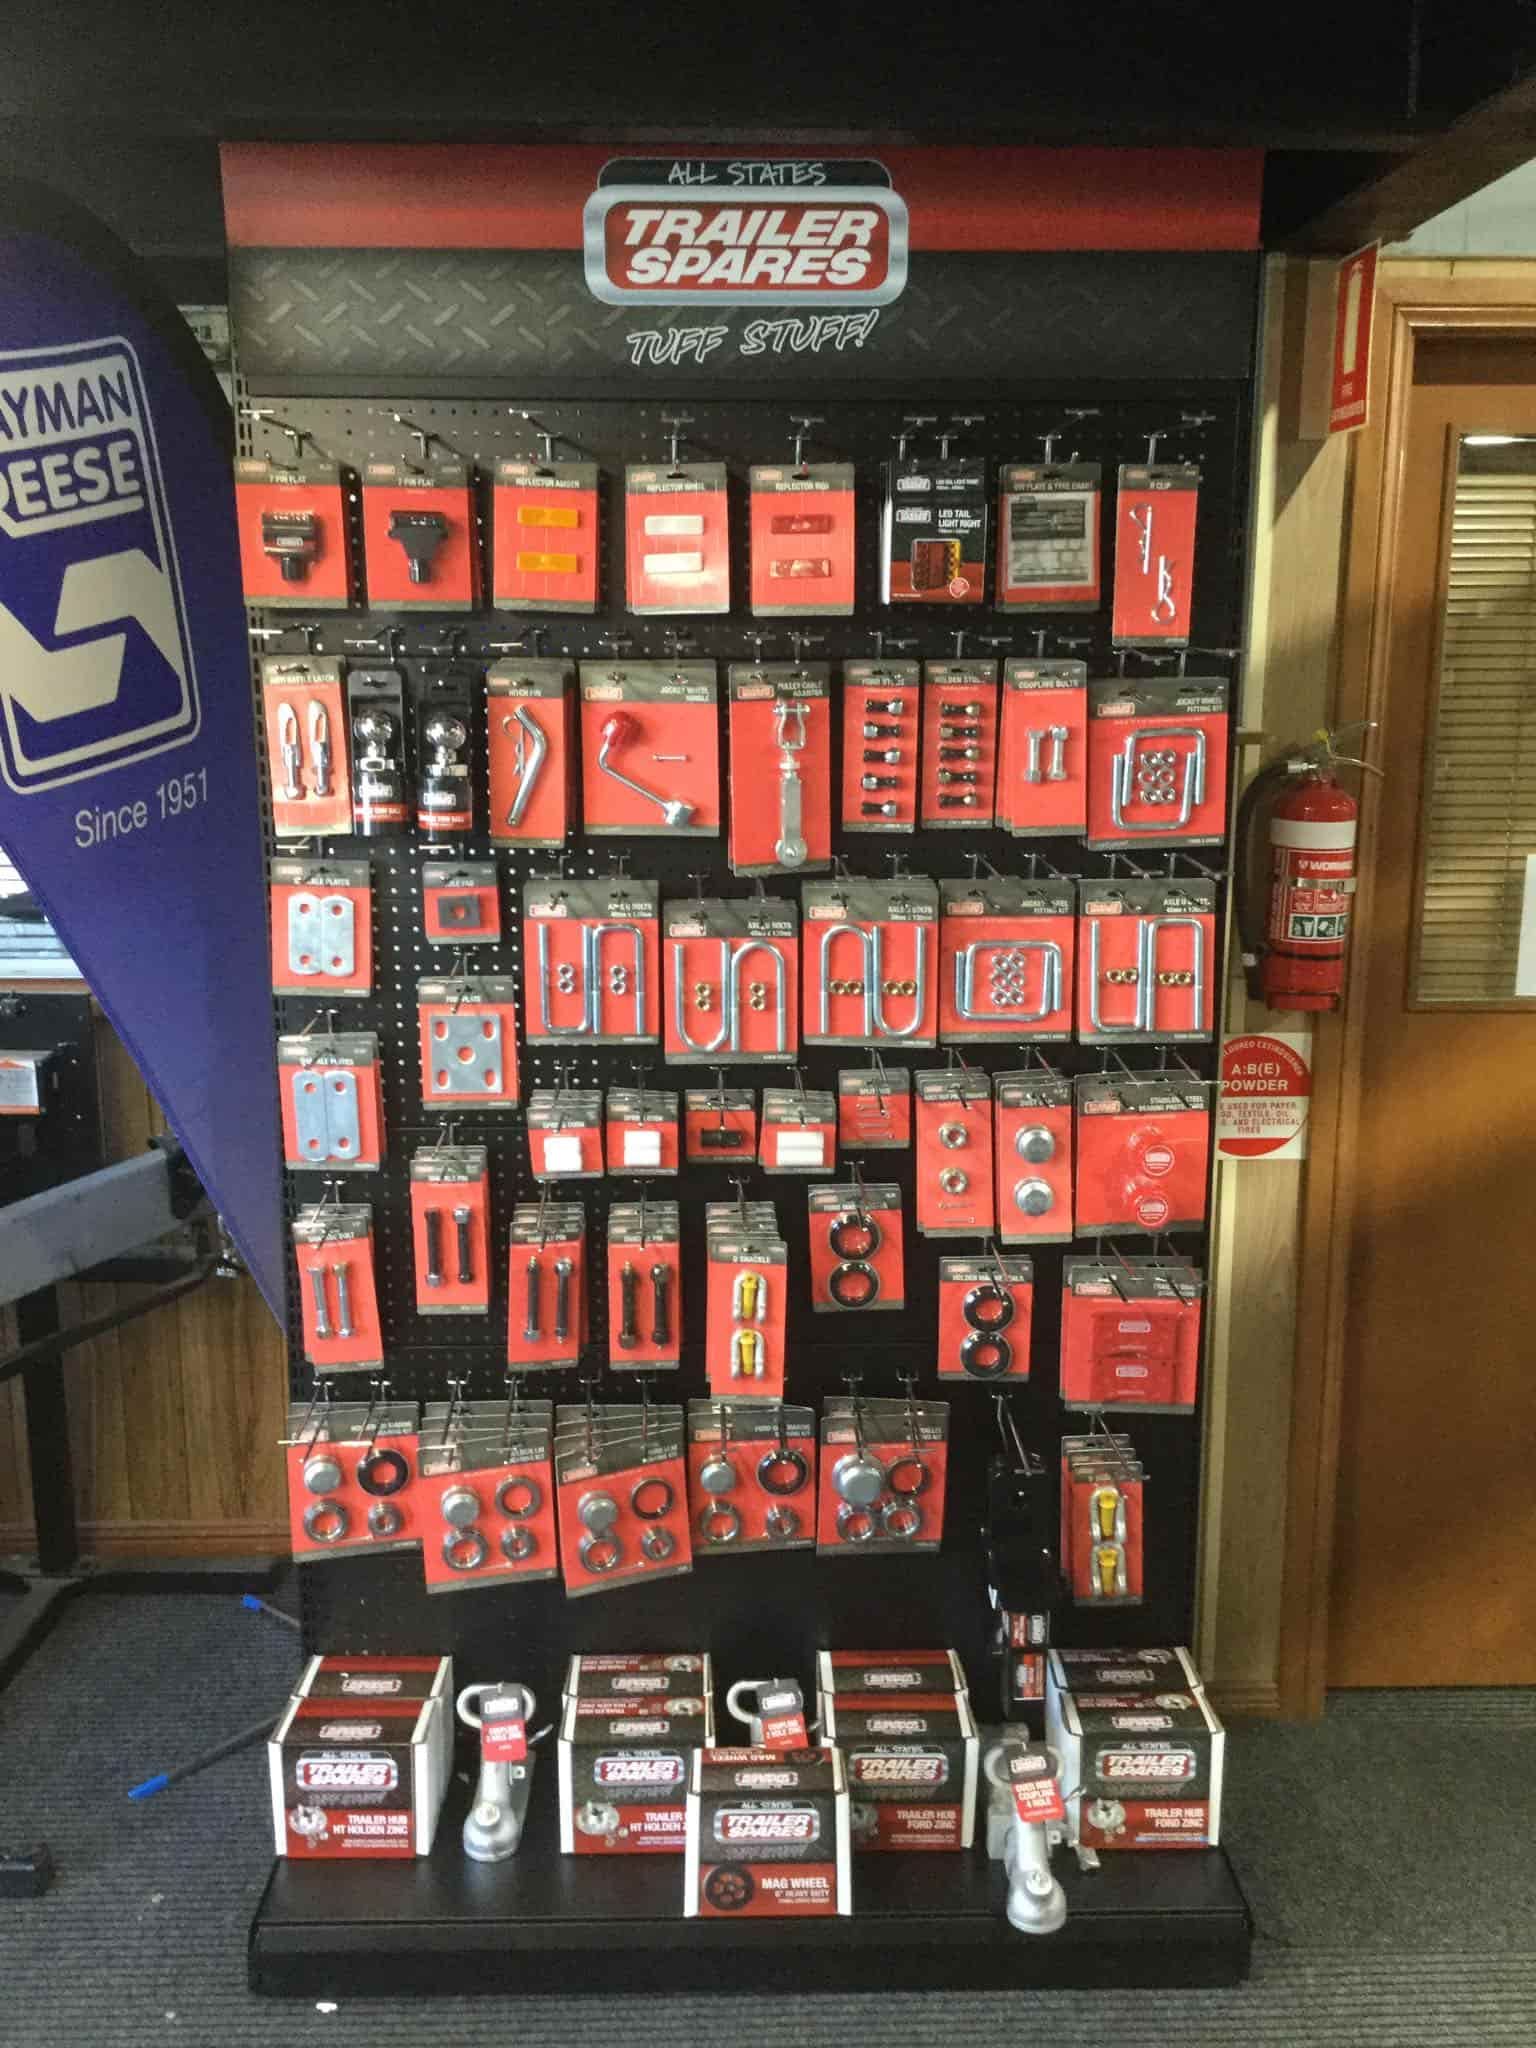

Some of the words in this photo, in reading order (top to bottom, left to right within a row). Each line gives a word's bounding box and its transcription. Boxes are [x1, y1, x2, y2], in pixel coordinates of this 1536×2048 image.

[668, 162, 717, 185] ALL
[726, 162, 827, 186] STATES
[624, 208, 880, 247] TRAILER
[626, 247, 873, 286] SPARES
[627, 326, 729, 365] TUFF
[739, 308, 880, 355] STUFF!
[938, 509, 954, 518] LED
[954, 509, 972, 518] TAIL
[938, 519, 958, 528] LIGHT
[959, 519, 981, 528] RIGHT
[74, 801, 148, 848] Since
[156, 767, 209, 818] 1951
[1221, 1079, 1288, 1092] POWDER
[860, 1760, 938, 1770] TRAILER
[1108, 1755, 1187, 1766] TRAILER
[308, 1764, 390, 1774] TRAILER
[605, 1762, 675, 1772] TRAILER
[1108, 1766, 1185, 1776] SPARES
[309, 1774, 387, 1785] SPARES
[862, 1770, 937, 1780] SPARES
[645, 1812, 683, 1821] TRAILER
[896, 1810, 935, 1820] TRAILER
[936, 1810, 956, 1819] HUB
[1144, 1808, 1183, 1817] TRAILER
[1184, 1808, 1204, 1817] HUB
[348, 1815, 387, 1824] TRAILER
[389, 1815, 408, 1824] HUB
[727, 1815, 810, 1826] TRAILER
[907, 1820, 930, 1829] FORD
[931, 1820, 956, 1829] ZINC
[1154, 1818, 1180, 1827] FORD
[1181, 1818, 1204, 1827] ZINC
[347, 1826, 385, 1835] HOLDEN
[386, 1826, 408, 1835] ZINC
[644, 1823, 682, 1832] HOLDEN
[727, 1826, 809, 1837] SPARES
[761, 1878, 789, 1889] MAG
[791, 1877, 829, 1889] WHEEL
